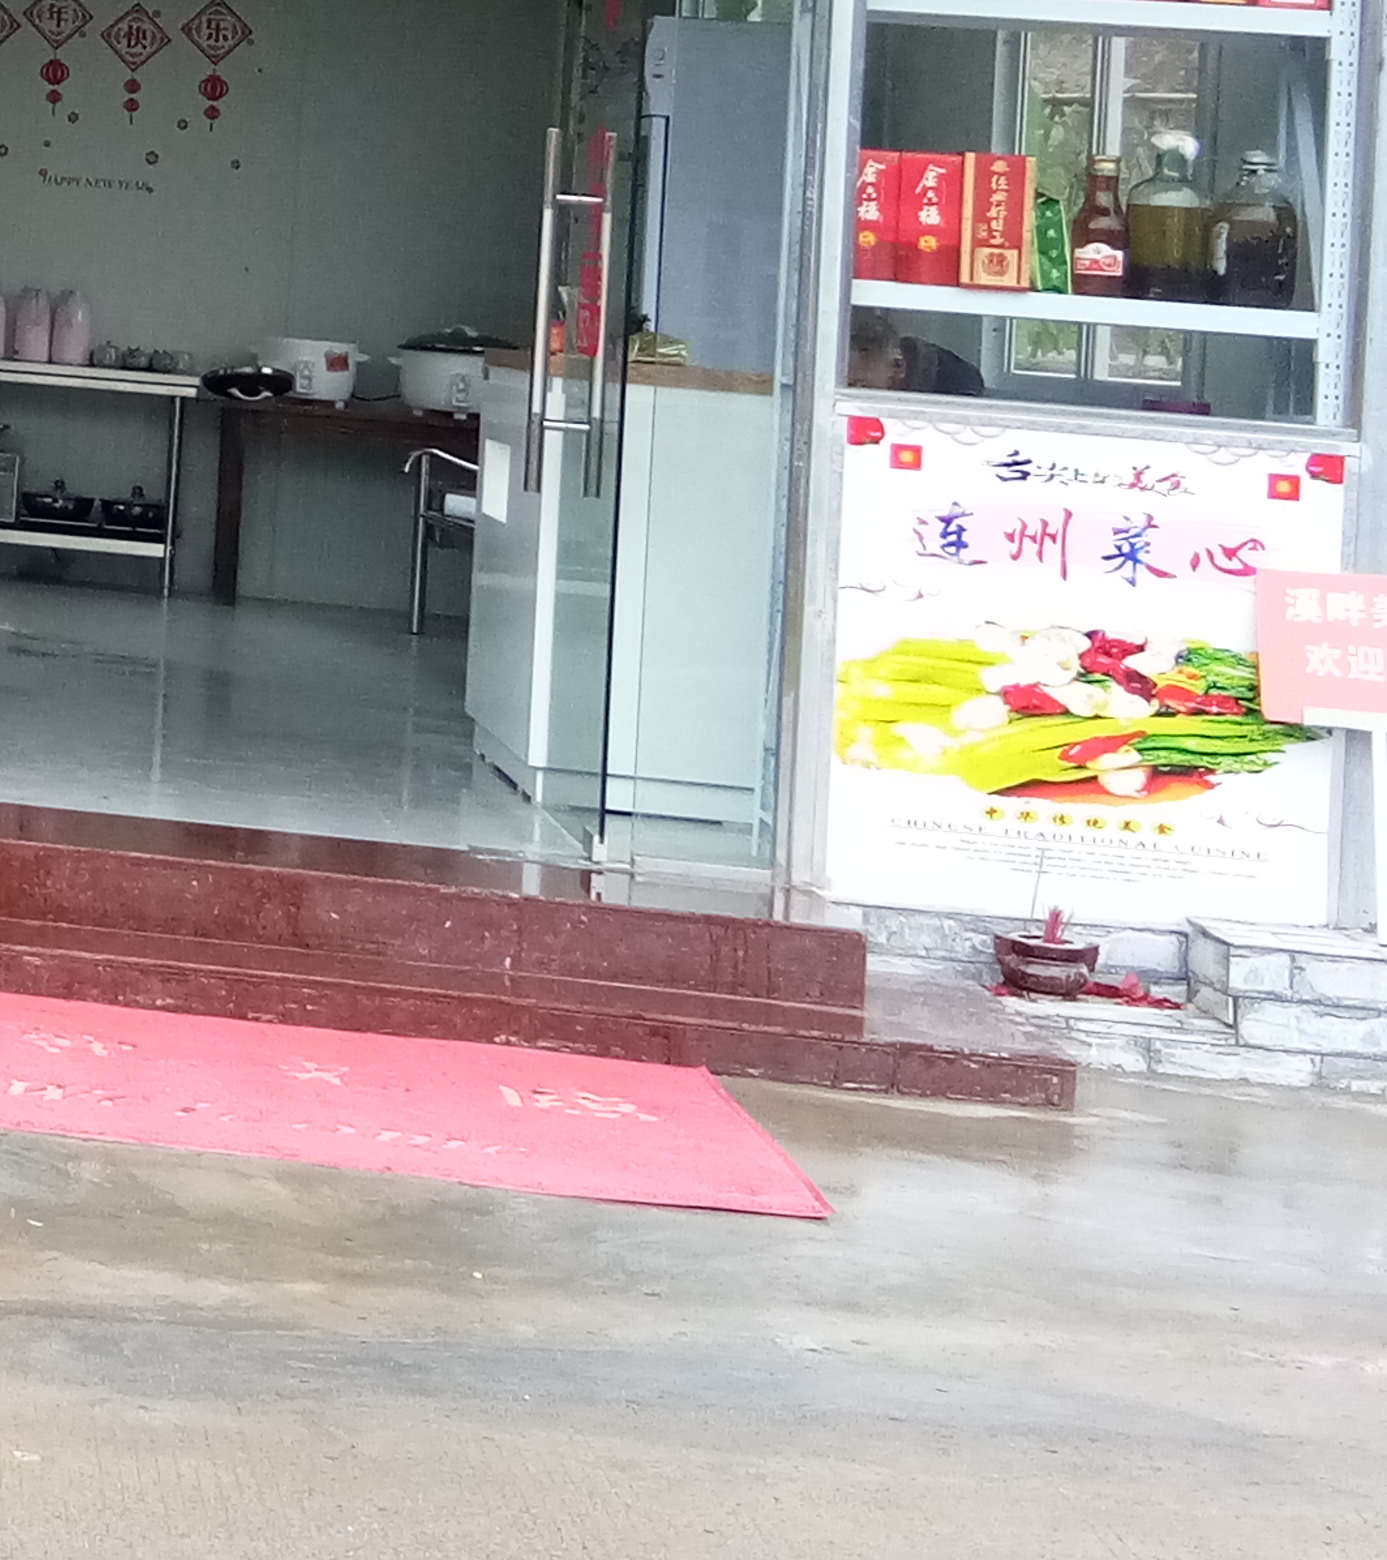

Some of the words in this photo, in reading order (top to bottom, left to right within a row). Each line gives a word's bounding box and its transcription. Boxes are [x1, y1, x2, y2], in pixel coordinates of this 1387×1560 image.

[915, 163, 947, 227] 金六福
[911, 501, 1266, 587] 连州菜心
[1304, 642, 1386, 682] 欢迎
[890, 816, 990, 836] CHINESE
[1001, 826, 1165, 853] TRADITIONAL
[1174, 843, 1270, 864] CUISINE
